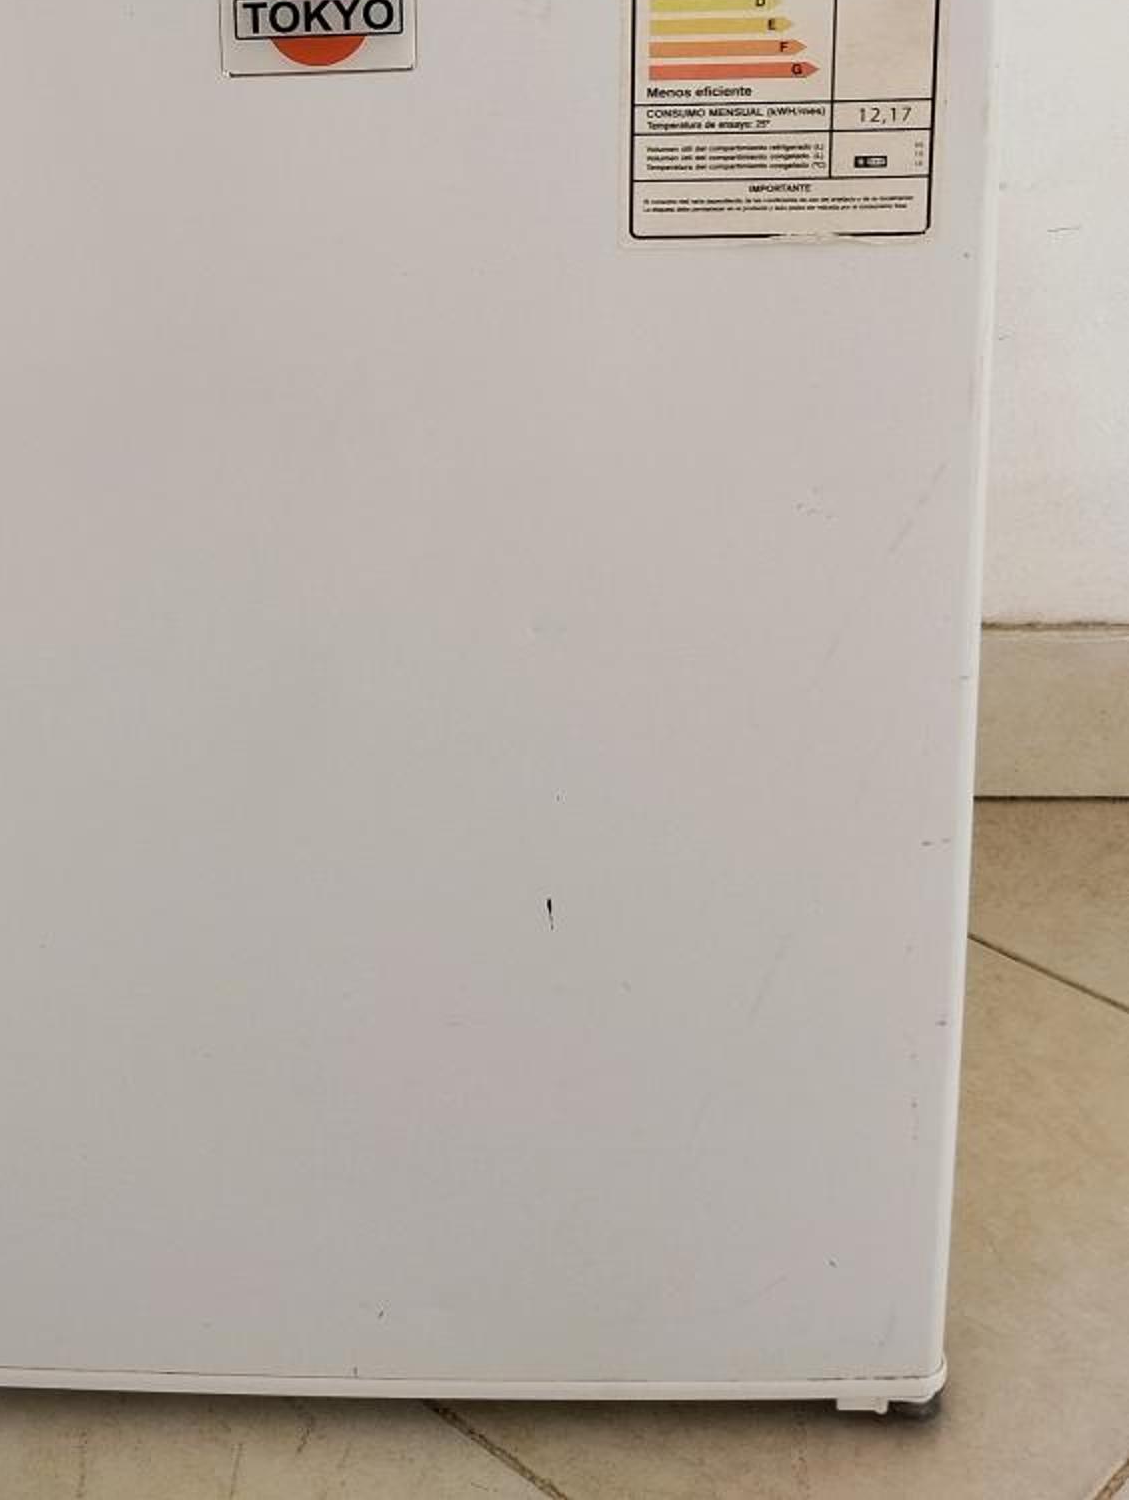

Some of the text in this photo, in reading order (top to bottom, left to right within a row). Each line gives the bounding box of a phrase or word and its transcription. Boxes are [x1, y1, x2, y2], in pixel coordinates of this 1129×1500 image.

[767, 19, 776, 31] E
[779, 41, 789, 52] F
[791, 63, 803, 75] G
[646, 85, 753, 99] Menos eficiente
[646, 109, 706, 119] CONSUMO
[709, 108, 763, 117] MENSUAL
[860, 107, 912, 124] 12,17
[647, 121, 702, 131] Temperatura
[704, 120, 716, 130] de
[748, 183, 812, 193] IMPORTANTE
